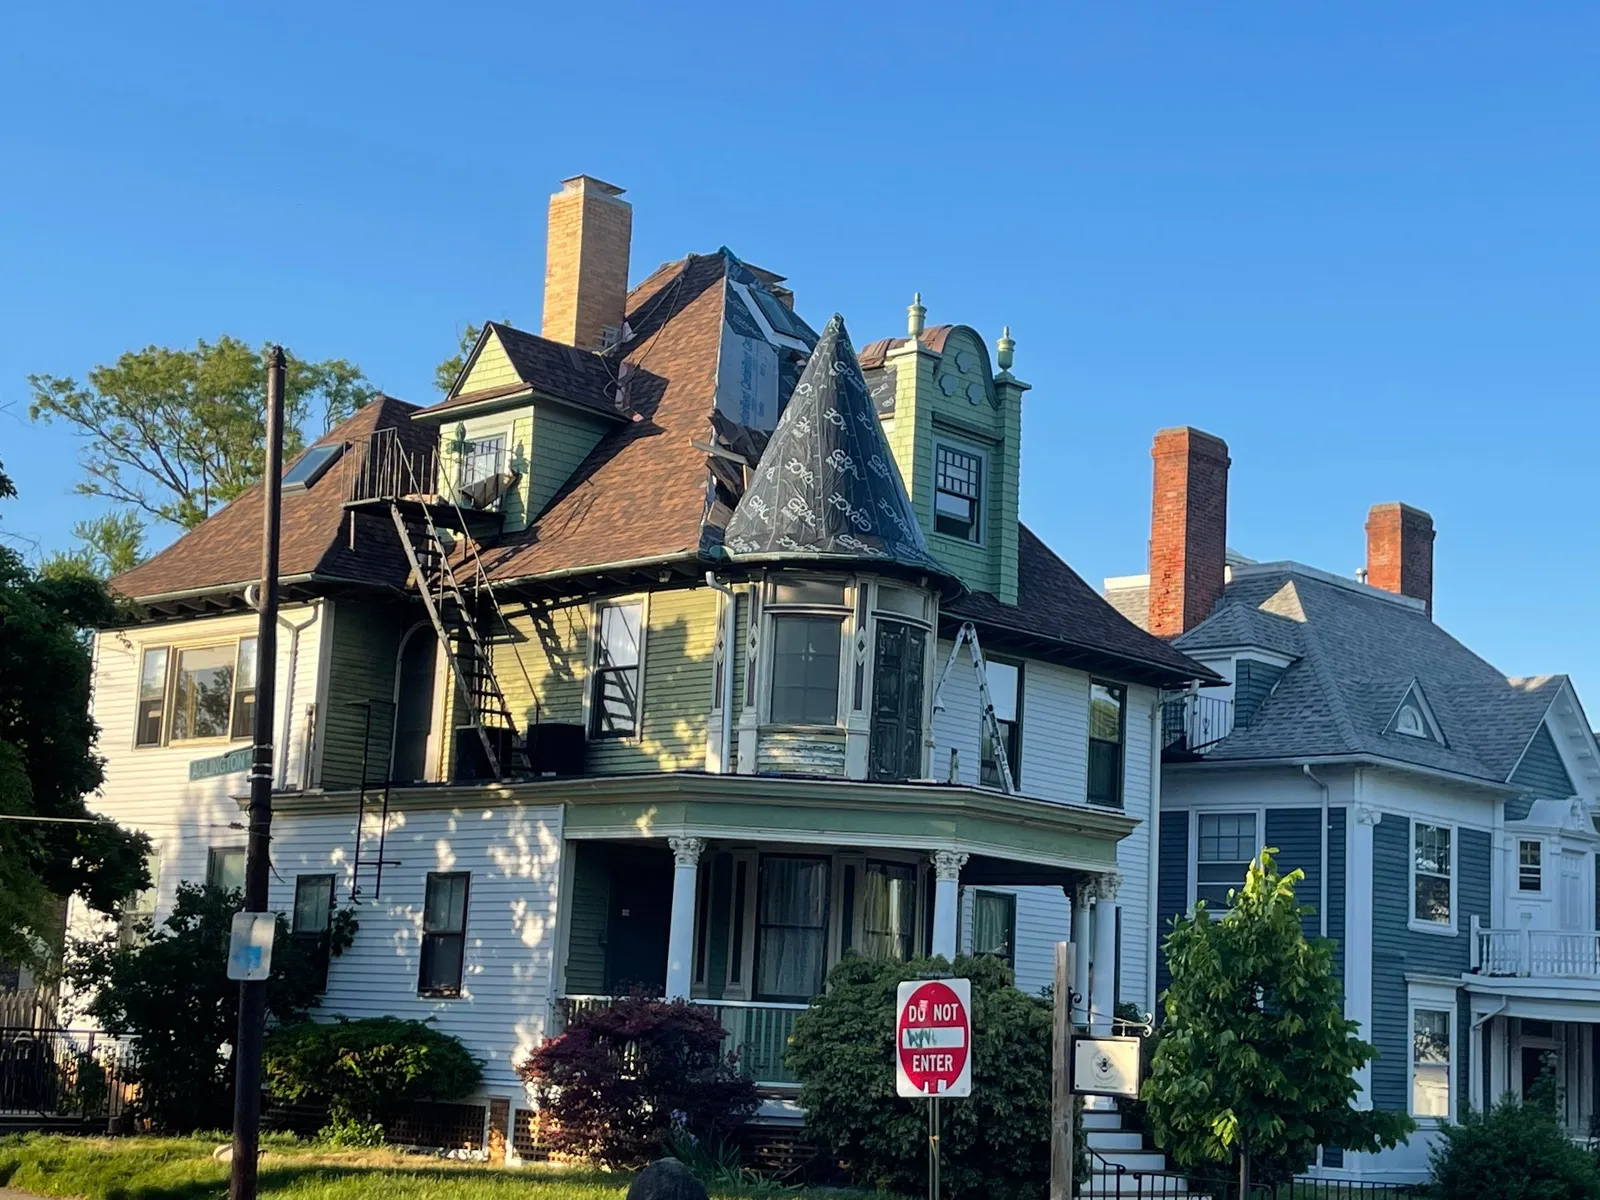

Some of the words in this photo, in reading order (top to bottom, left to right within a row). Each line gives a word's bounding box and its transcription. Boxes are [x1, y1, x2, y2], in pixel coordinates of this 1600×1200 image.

[827, 492, 872, 532] GRACE
[191, 753, 245, 779] ARLINGTON
[908, 1003, 927, 1022] DO
[933, 1003, 959, 1022] NOT
[912, 1054, 953, 1072] ENTER
